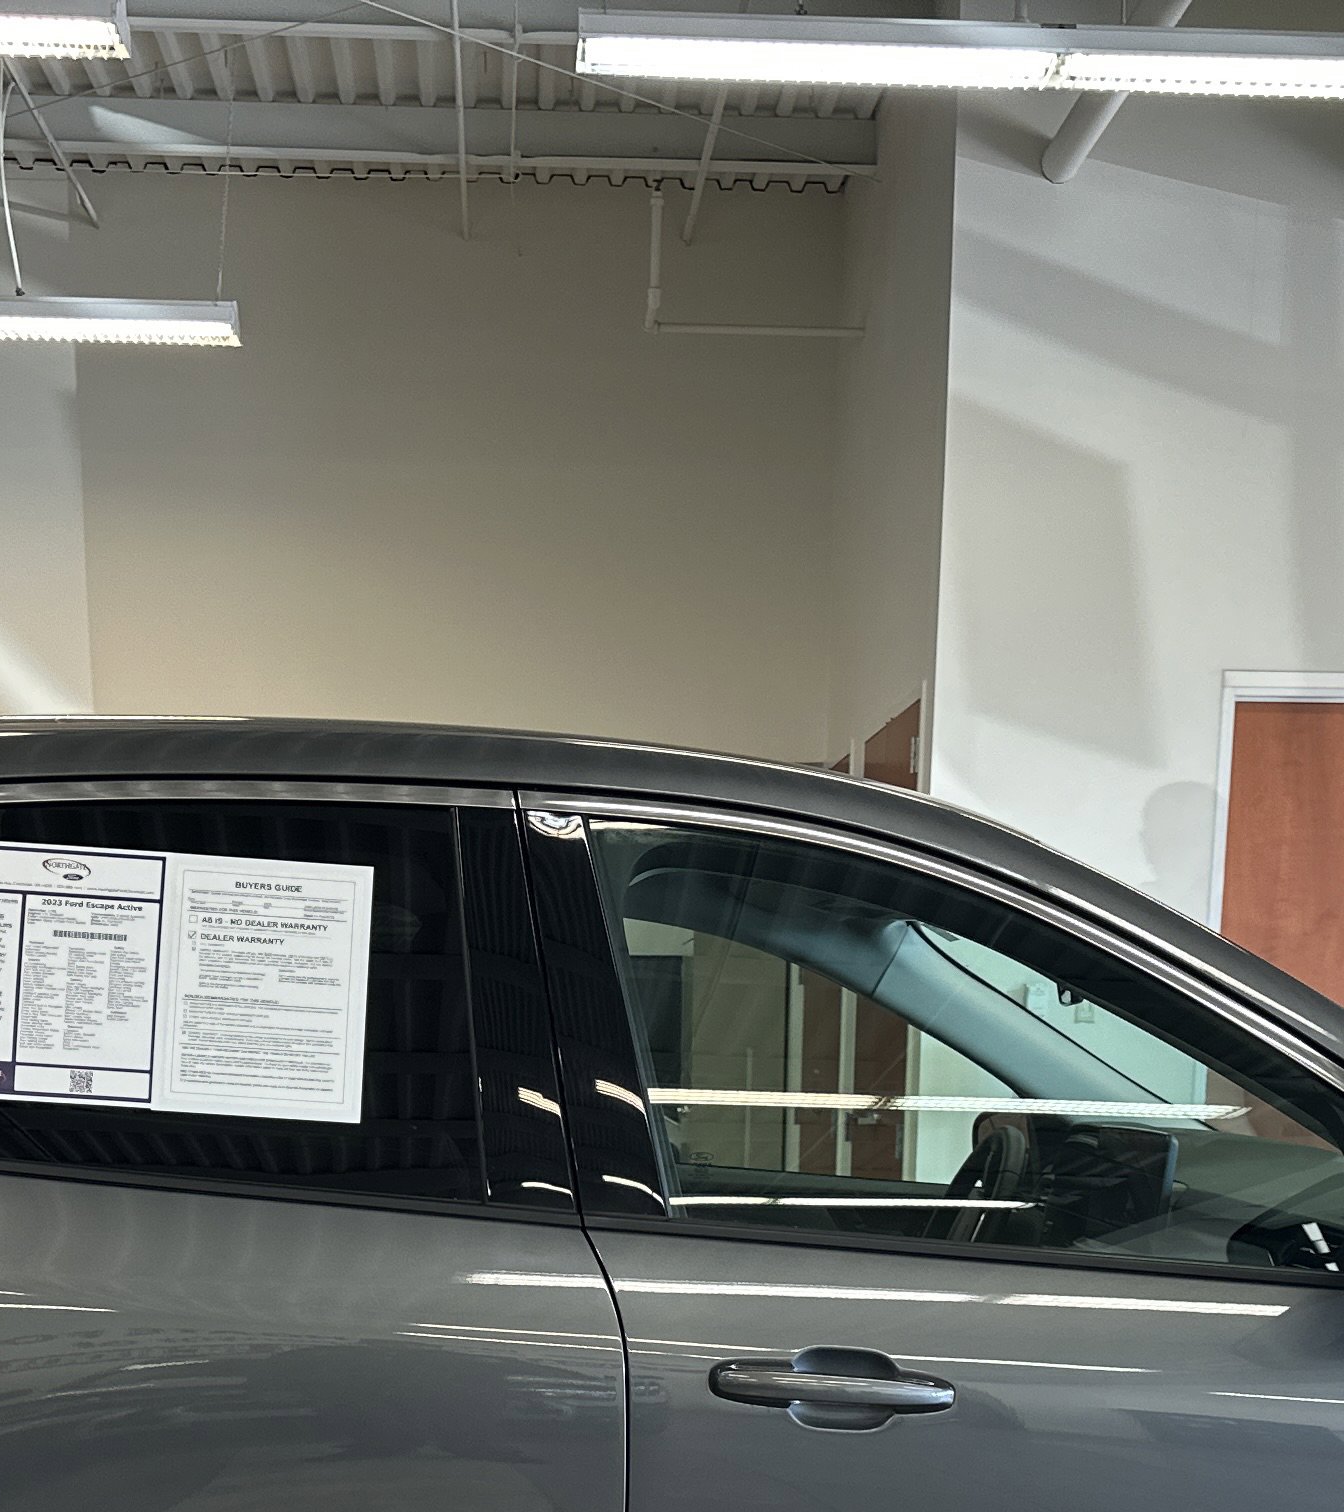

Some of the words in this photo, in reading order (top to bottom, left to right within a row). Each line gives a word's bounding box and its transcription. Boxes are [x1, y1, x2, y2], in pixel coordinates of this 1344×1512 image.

[235, 881, 272, 891] BUYERS
[275, 884, 303, 893] GUIDE
[41, 898, 62, 907] 2023
[65, 900, 84, 908] Ford
[86, 901, 114, 911] Escape
[117, 903, 143, 912] Active
[245, 918, 278, 929] DEALER
[281, 921, 328, 932] WARRANTY
[200, 933, 234, 942] DEALER
[237, 935, 285, 945] WARRANTY
